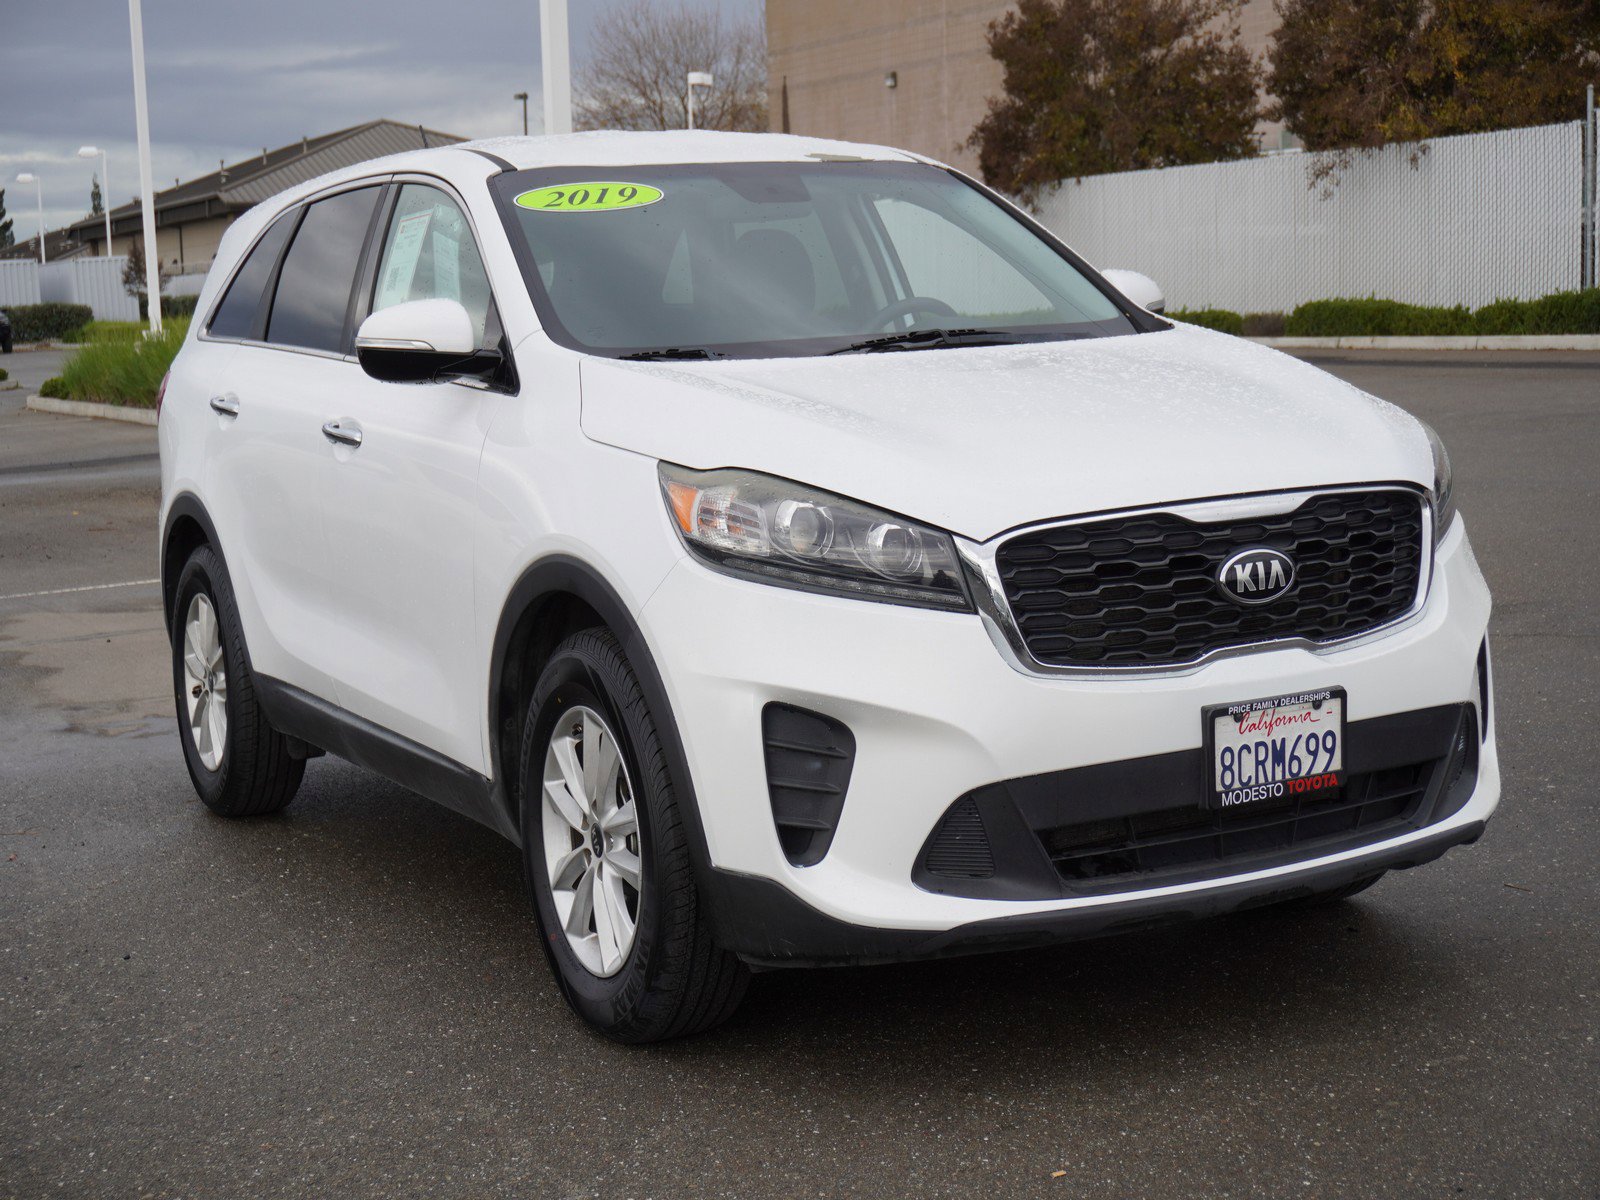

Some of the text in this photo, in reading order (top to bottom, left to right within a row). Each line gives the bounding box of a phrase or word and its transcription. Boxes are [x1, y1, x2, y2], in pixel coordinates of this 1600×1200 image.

[543, 187, 638, 208] 2019
[1234, 559, 1286, 593] KIA
[1228, 691, 1331, 715] PRICE FAMILY DEALERSHIPS
[1238, 708, 1321, 737] California
[1220, 729, 1337, 791] 8CRM699
[1221, 773, 1338, 807] MODESTO TOYOTA
